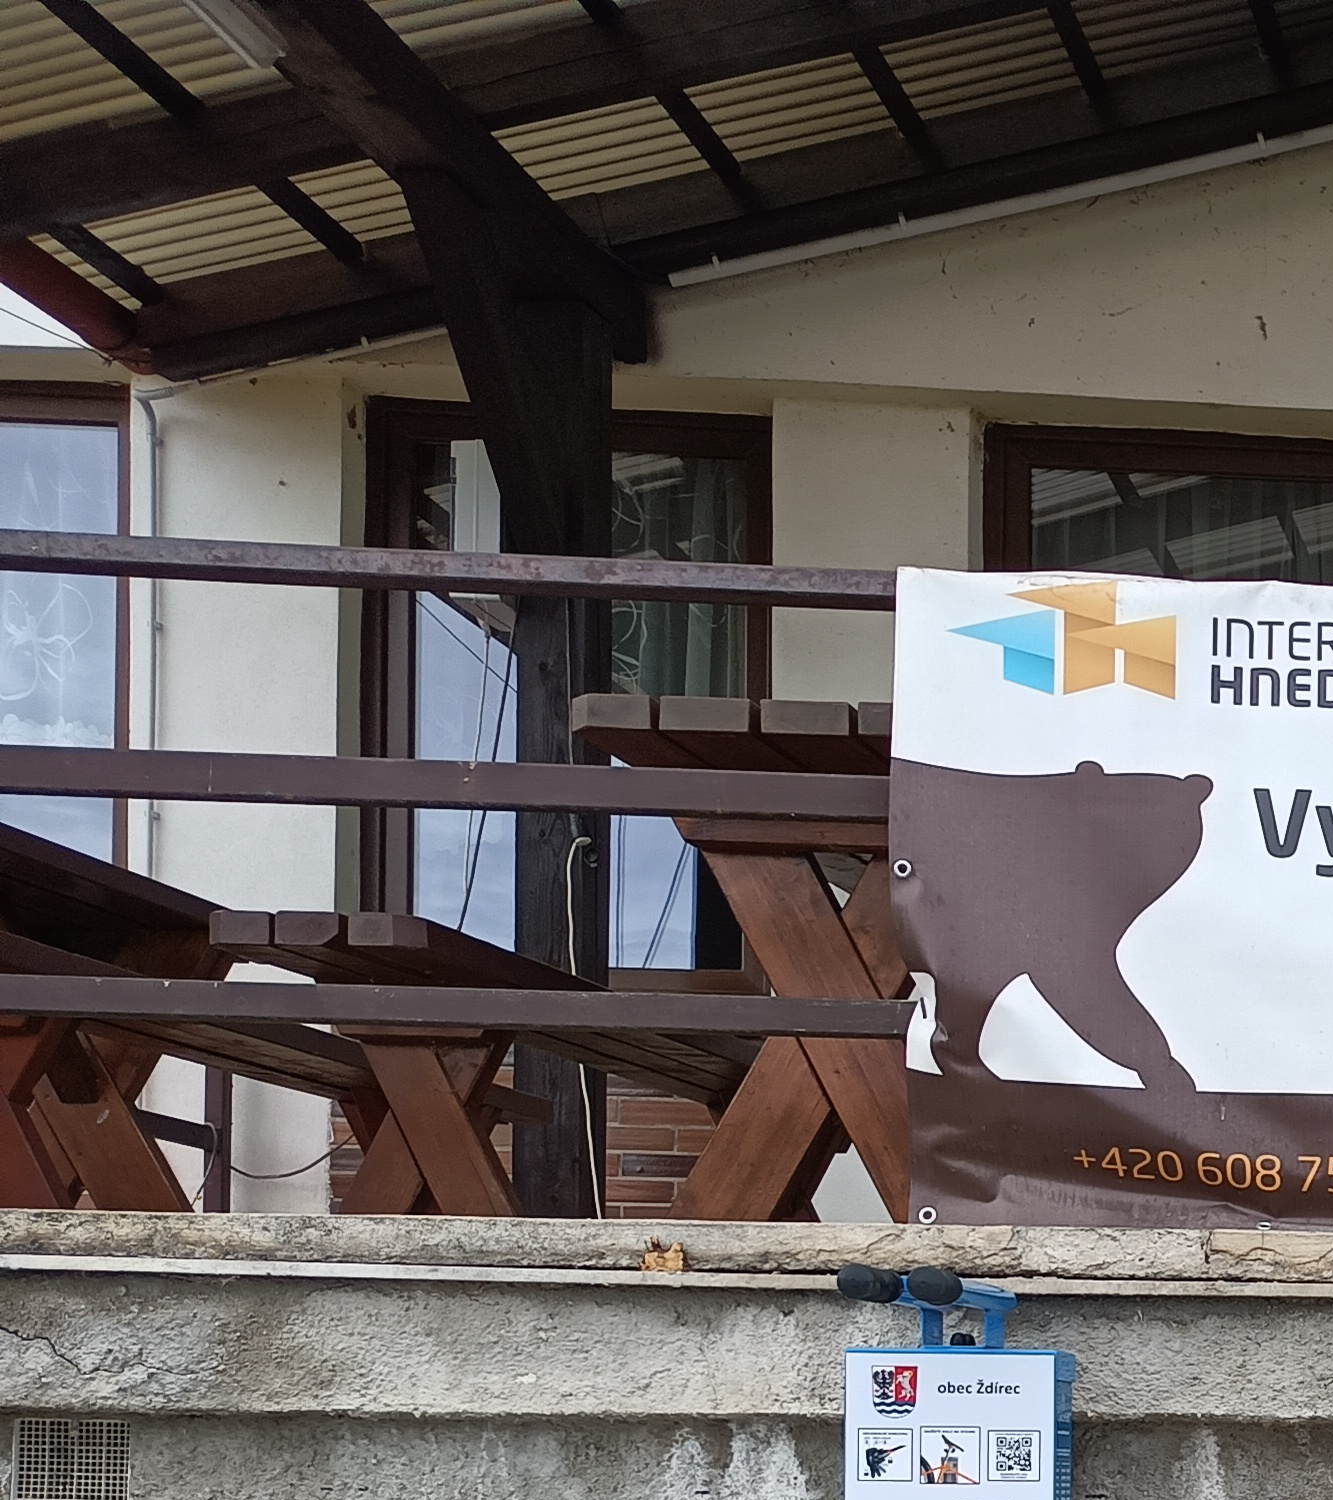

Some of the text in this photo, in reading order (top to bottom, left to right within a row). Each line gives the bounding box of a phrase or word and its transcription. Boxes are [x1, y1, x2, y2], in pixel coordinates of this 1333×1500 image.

[1074, 1147, 1183, 1182] +420
[1198, 1152, 1281, 1192] 608
[938, 1379, 1020, 1395] obec Ždírec
